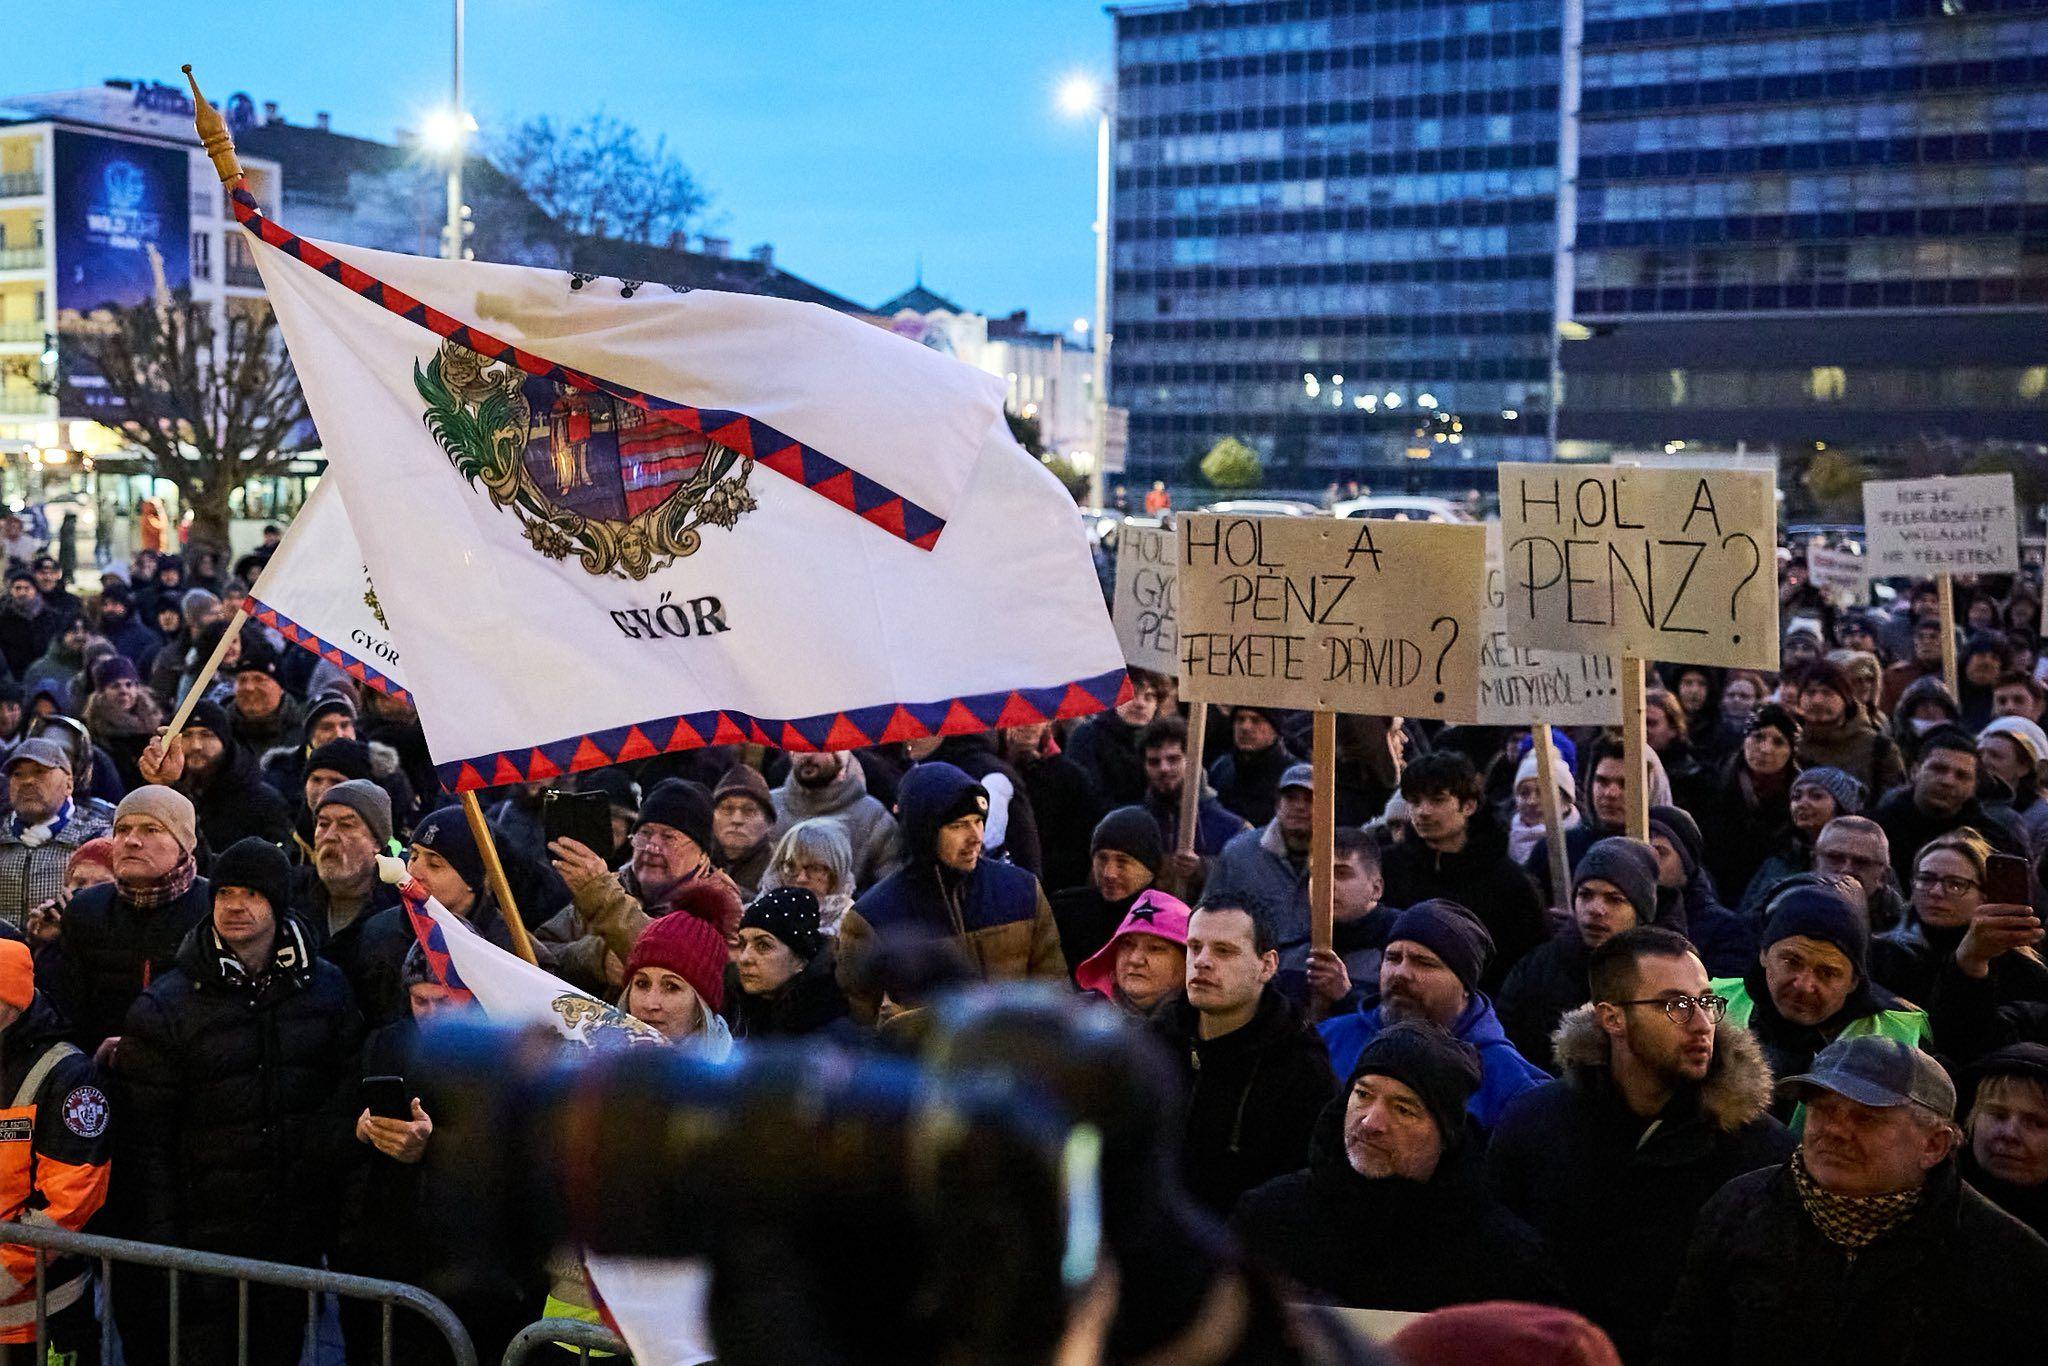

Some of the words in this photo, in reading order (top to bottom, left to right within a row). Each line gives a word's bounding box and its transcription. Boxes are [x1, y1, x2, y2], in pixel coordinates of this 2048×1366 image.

[1520, 477, 1646, 528] HOL
[1681, 477, 1722, 536] A
[1122, 528, 1176, 566] HOL
[1185, 518, 1285, 568] HOL
[1344, 524, 1384, 572] A
[609, 590, 732, 640] GYŐR
[1219, 567, 1356, 626] PÉNZ
[350, 627, 400, 667] GYŐR
[1181, 632, 1306, 681] FEKETE
